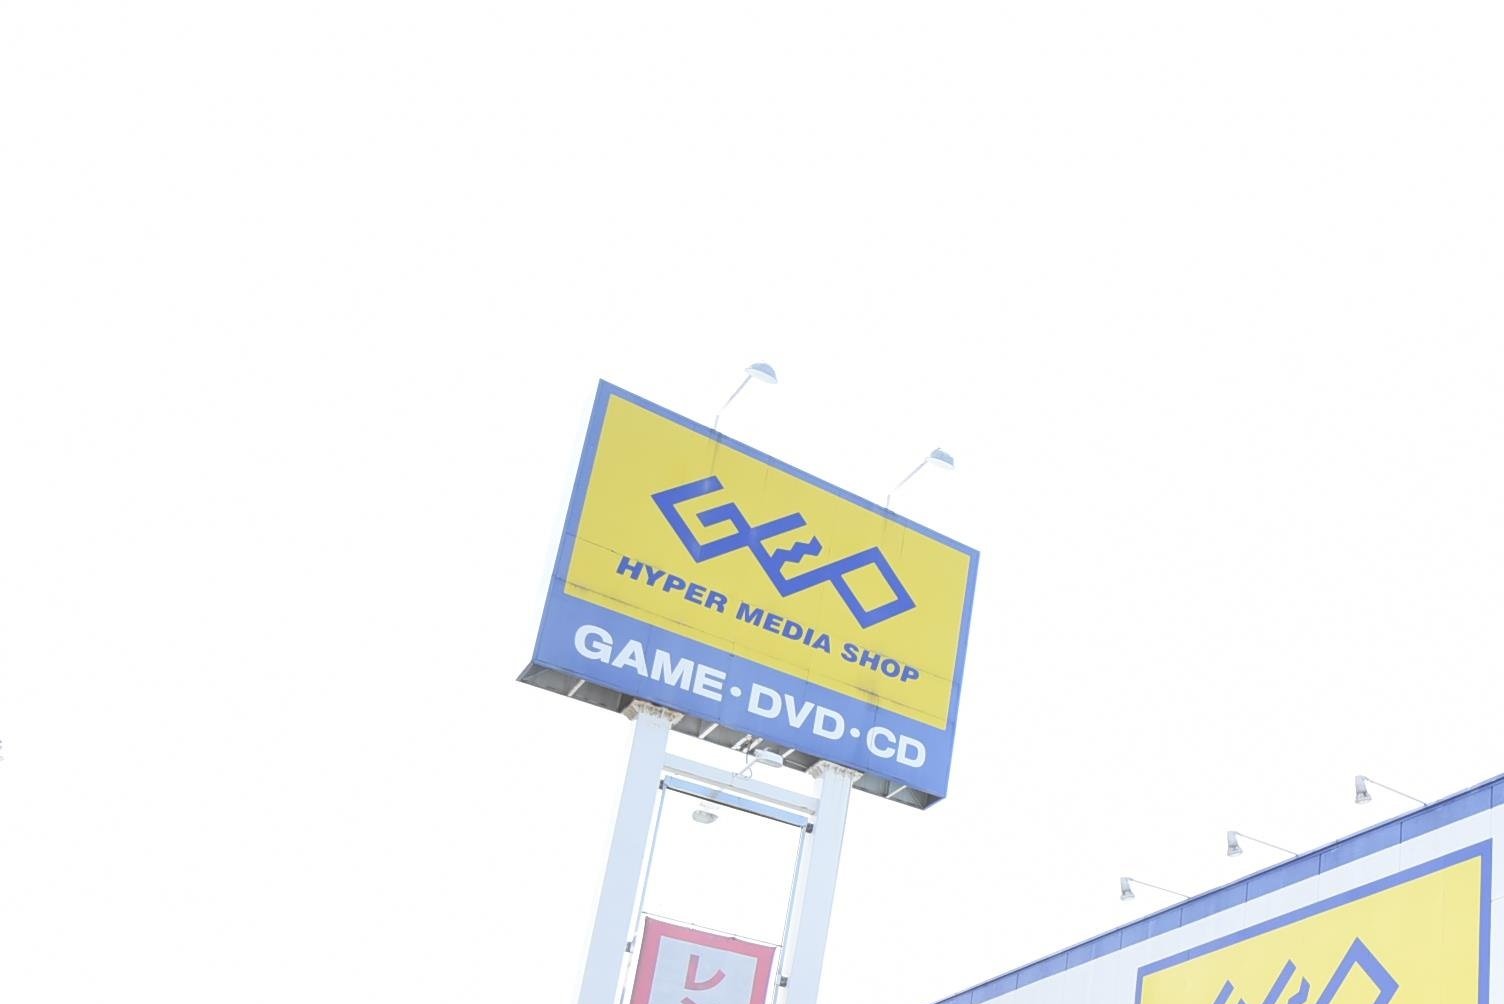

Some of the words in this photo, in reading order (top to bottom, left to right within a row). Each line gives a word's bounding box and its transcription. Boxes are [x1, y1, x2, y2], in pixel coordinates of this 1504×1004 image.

[615, 555, 728, 613] HYPER
[735, 602, 832, 653] MEDIA
[841, 642, 920, 684] SHOP
[650, 474, 917, 630] GEO
